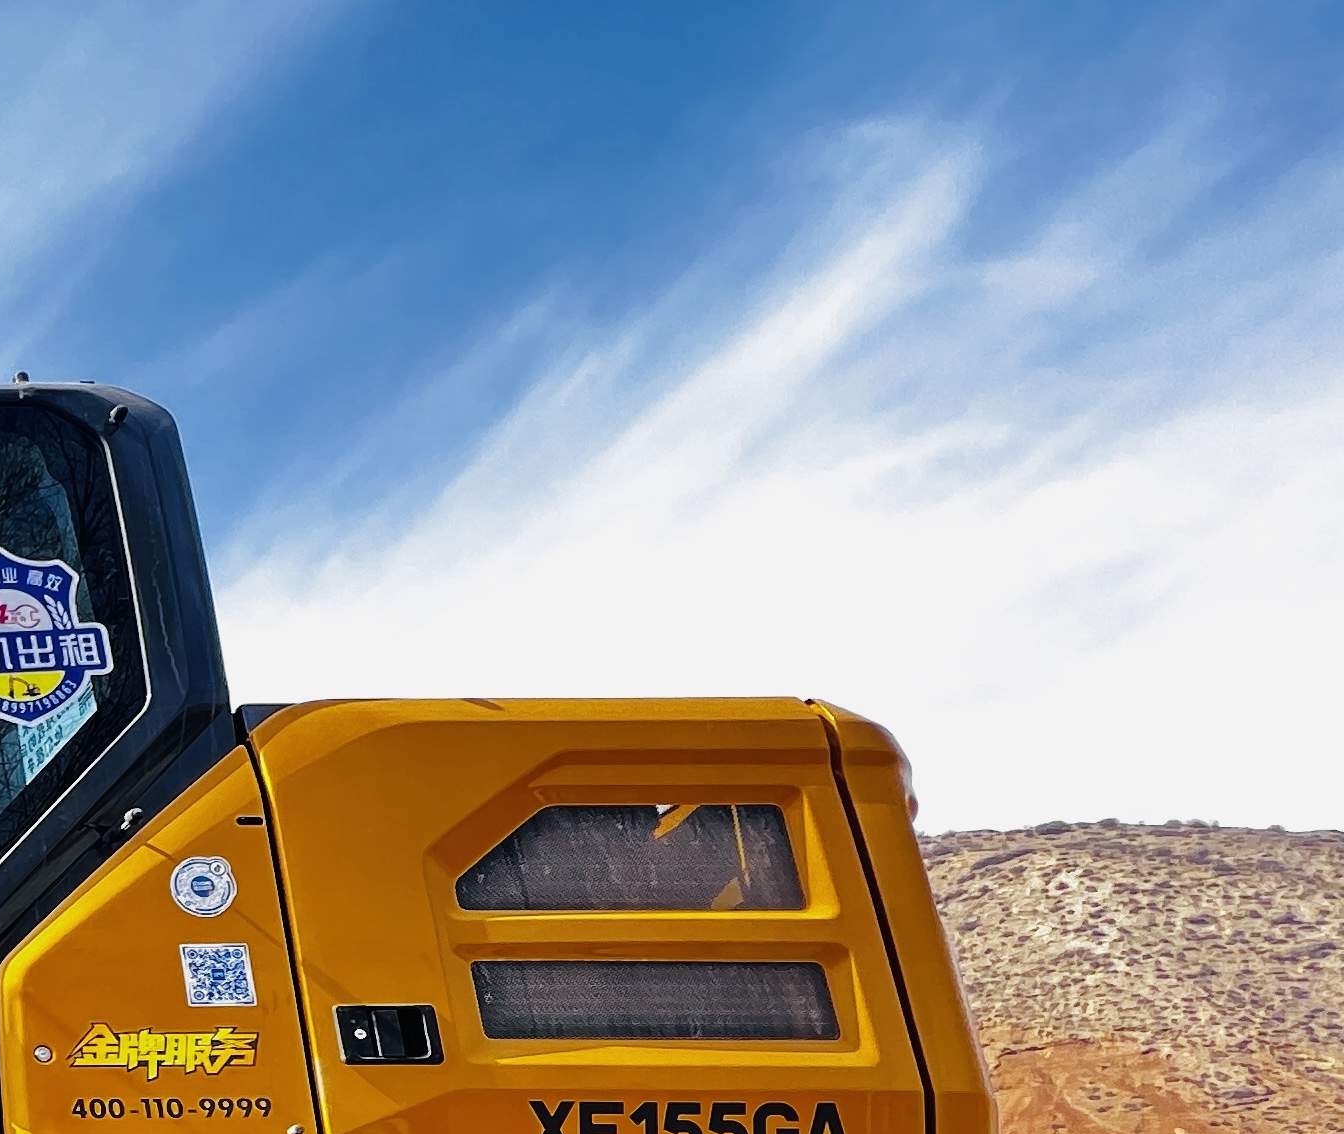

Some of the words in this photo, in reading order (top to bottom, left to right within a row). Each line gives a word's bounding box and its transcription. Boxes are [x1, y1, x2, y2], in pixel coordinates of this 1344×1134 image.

[26, 569, 64, 592] 高效
[66, 1022, 260, 1082] 金牌服务
[71, 1097, 273, 1120] 400-110-9999
